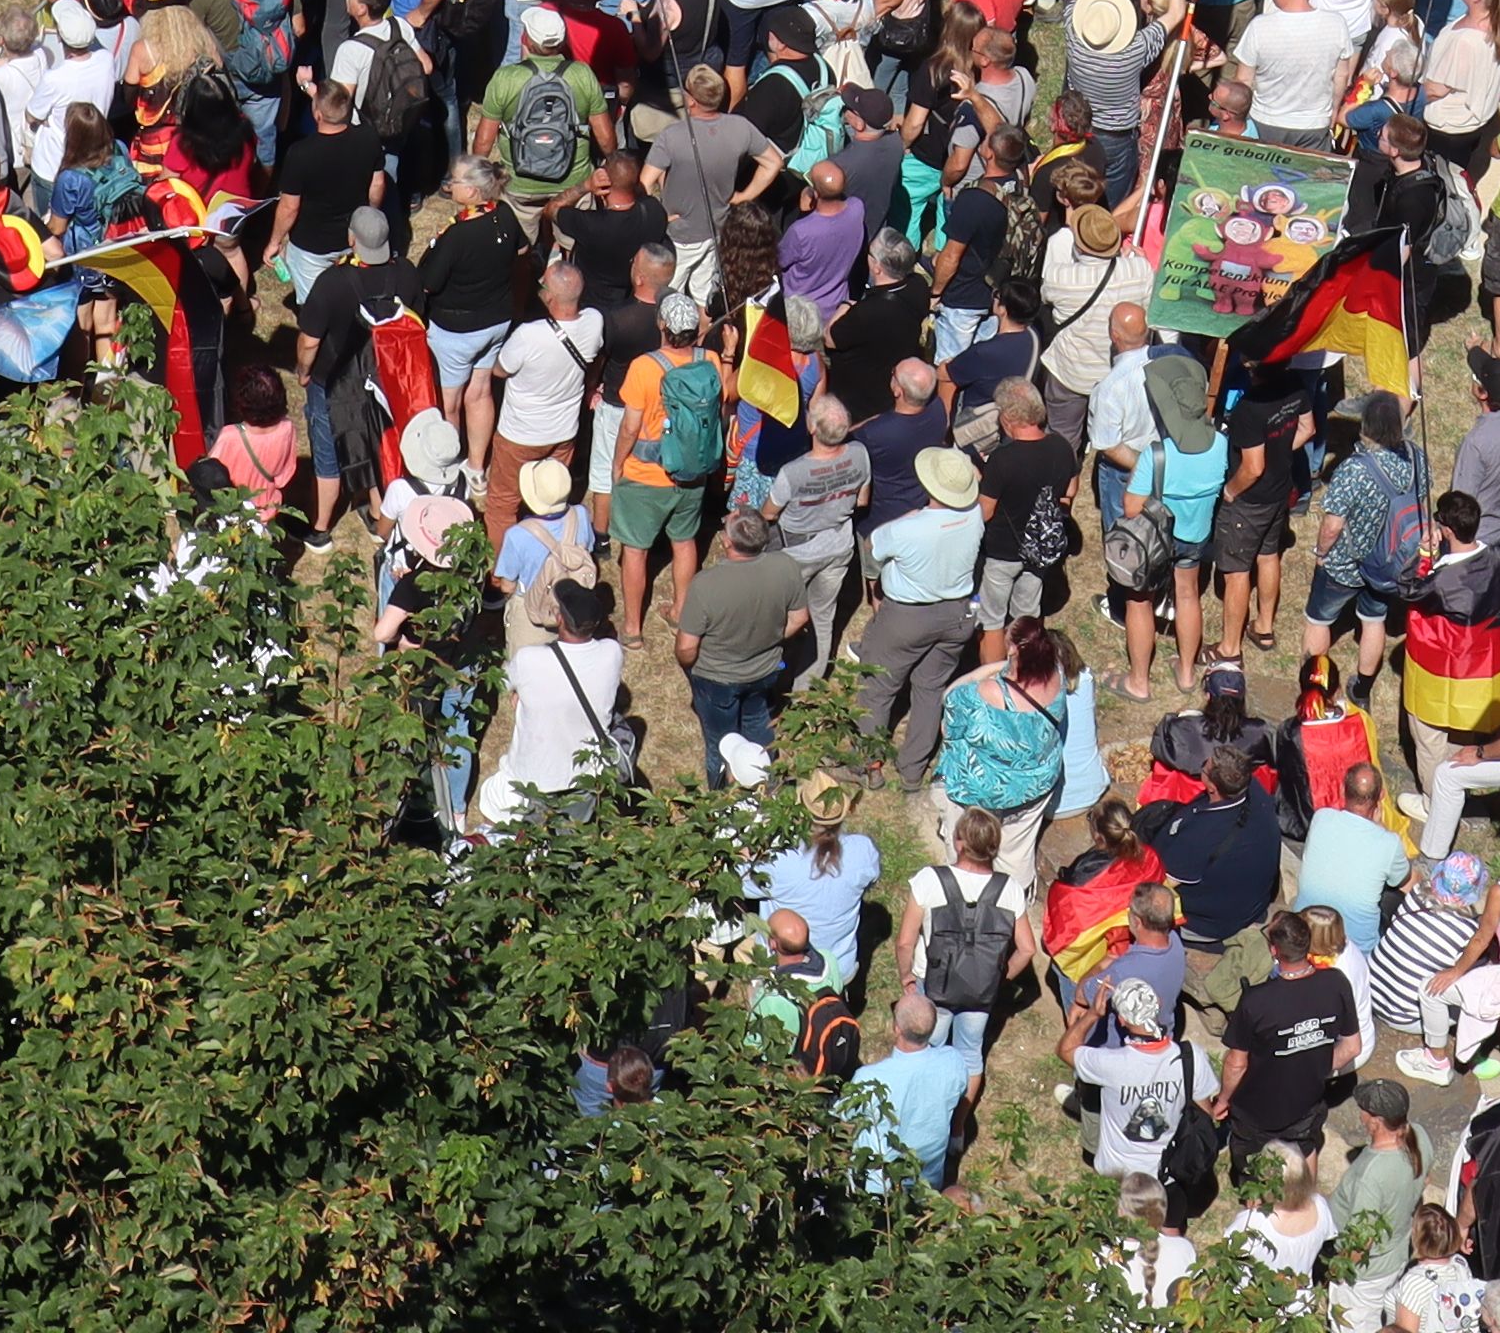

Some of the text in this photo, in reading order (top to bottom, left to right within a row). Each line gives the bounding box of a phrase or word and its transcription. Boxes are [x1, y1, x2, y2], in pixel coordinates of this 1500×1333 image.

[1190, 137, 1292, 167] Der geballte
[1164, 258, 1293, 288] Kompetenzklum
[1164, 273, 1190, 290] für
[1233, 288, 1283, 305] Proble
[1119, 1077, 1183, 1107] UNHOLY
